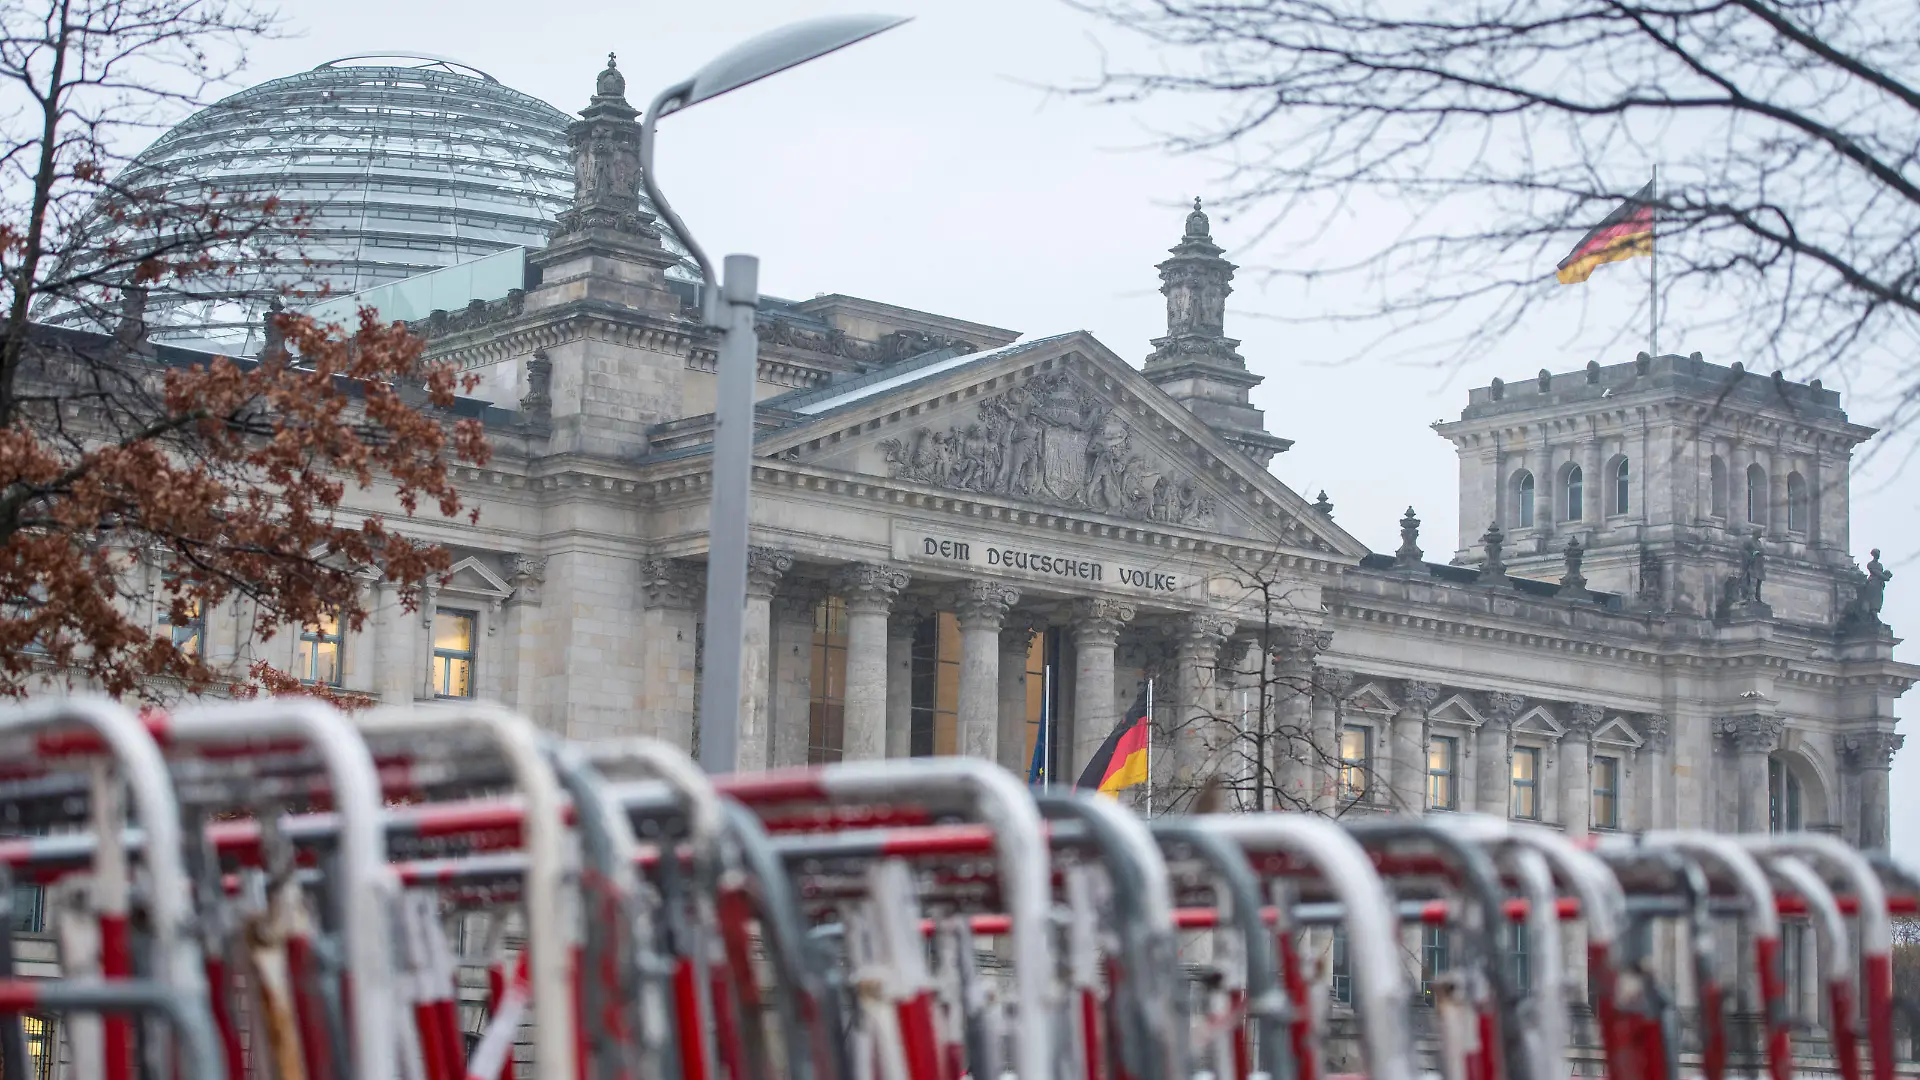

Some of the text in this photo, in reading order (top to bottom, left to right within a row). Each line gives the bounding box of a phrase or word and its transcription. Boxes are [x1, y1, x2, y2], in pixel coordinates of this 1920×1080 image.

[923, 537, 1176, 592] DEM DEUTSCHEN VOLKE
